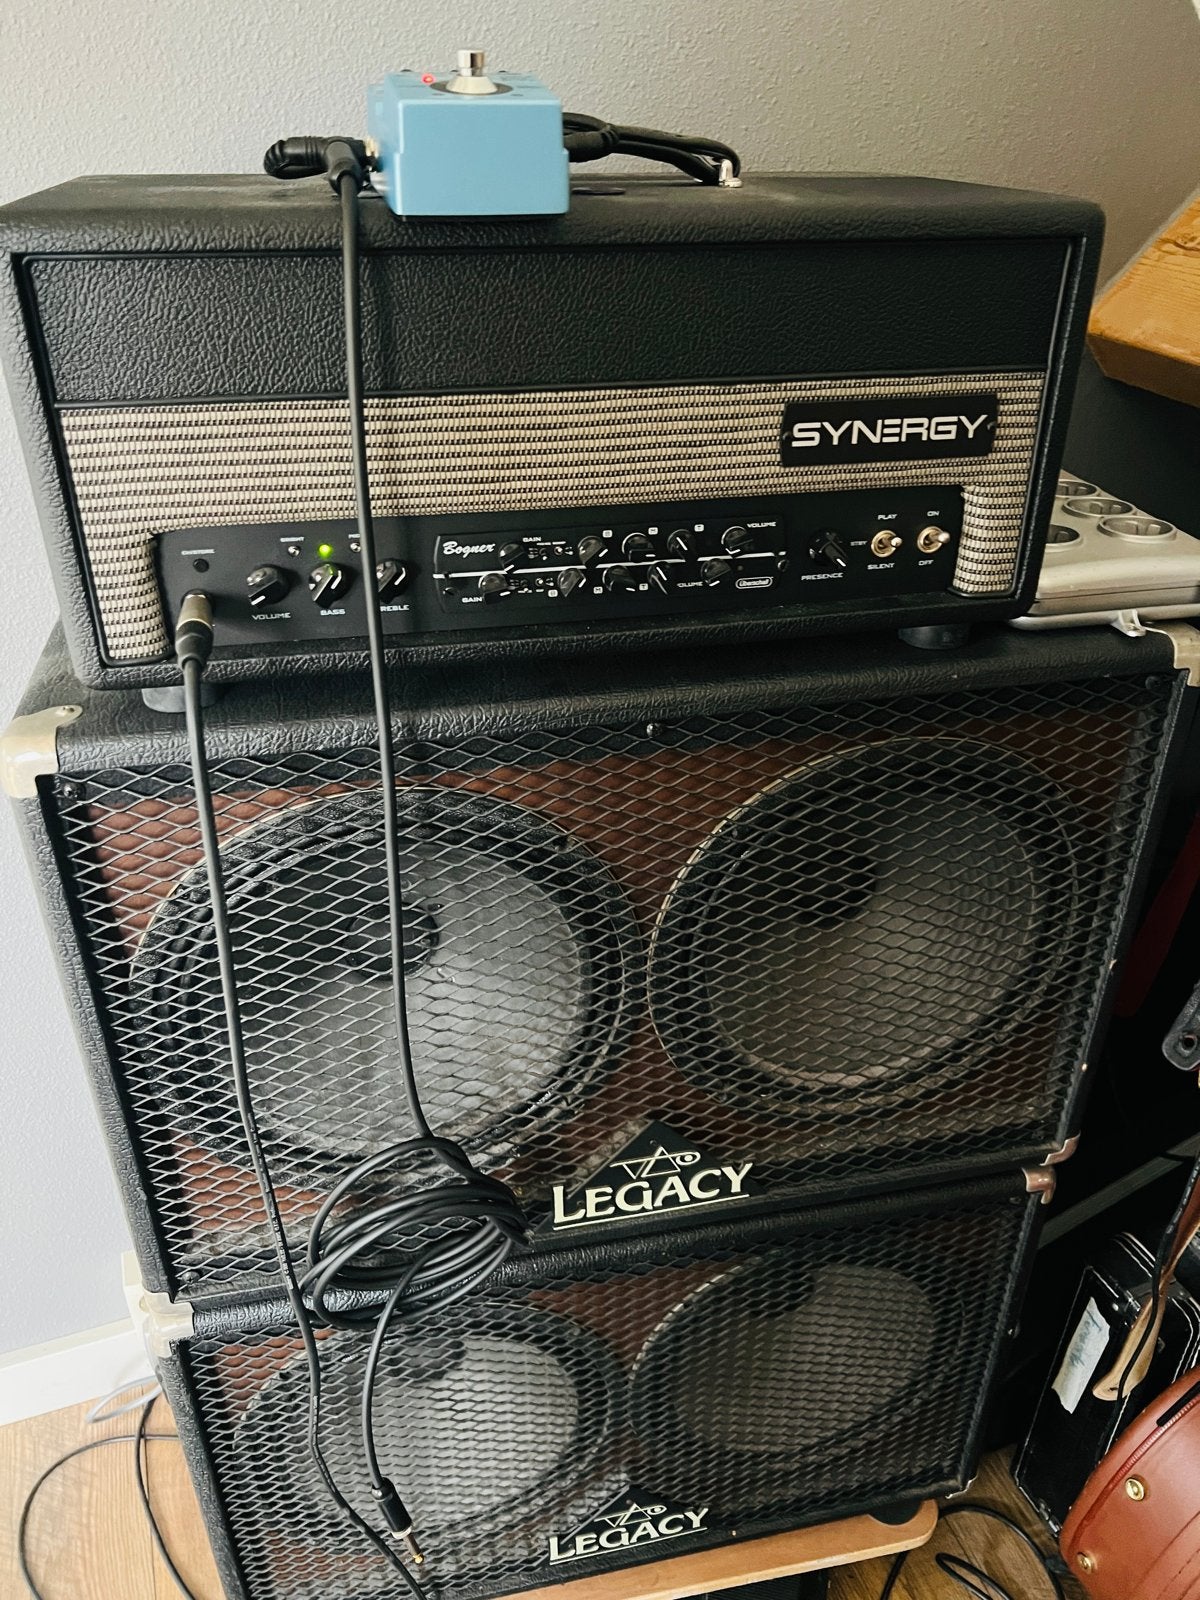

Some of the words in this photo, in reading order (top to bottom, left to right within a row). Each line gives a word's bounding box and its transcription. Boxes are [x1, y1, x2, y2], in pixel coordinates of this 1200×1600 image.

[791, 414, 988, 448] SYNERGY
[877, 513, 897, 521] PLAY
[442, 540, 496, 559] Bogner
[867, 562, 895, 571] SILENT
[918, 559, 934, 567] OFF
[800, 572, 844, 581] PRESENCE
[461, 596, 483, 604] GAIN
[251, 612, 291, 621] VOLUME
[320, 608, 346, 617] BASS
[552, 1162, 754, 1225] LEGACY
[549, 1507, 709, 1561] LEGACY
